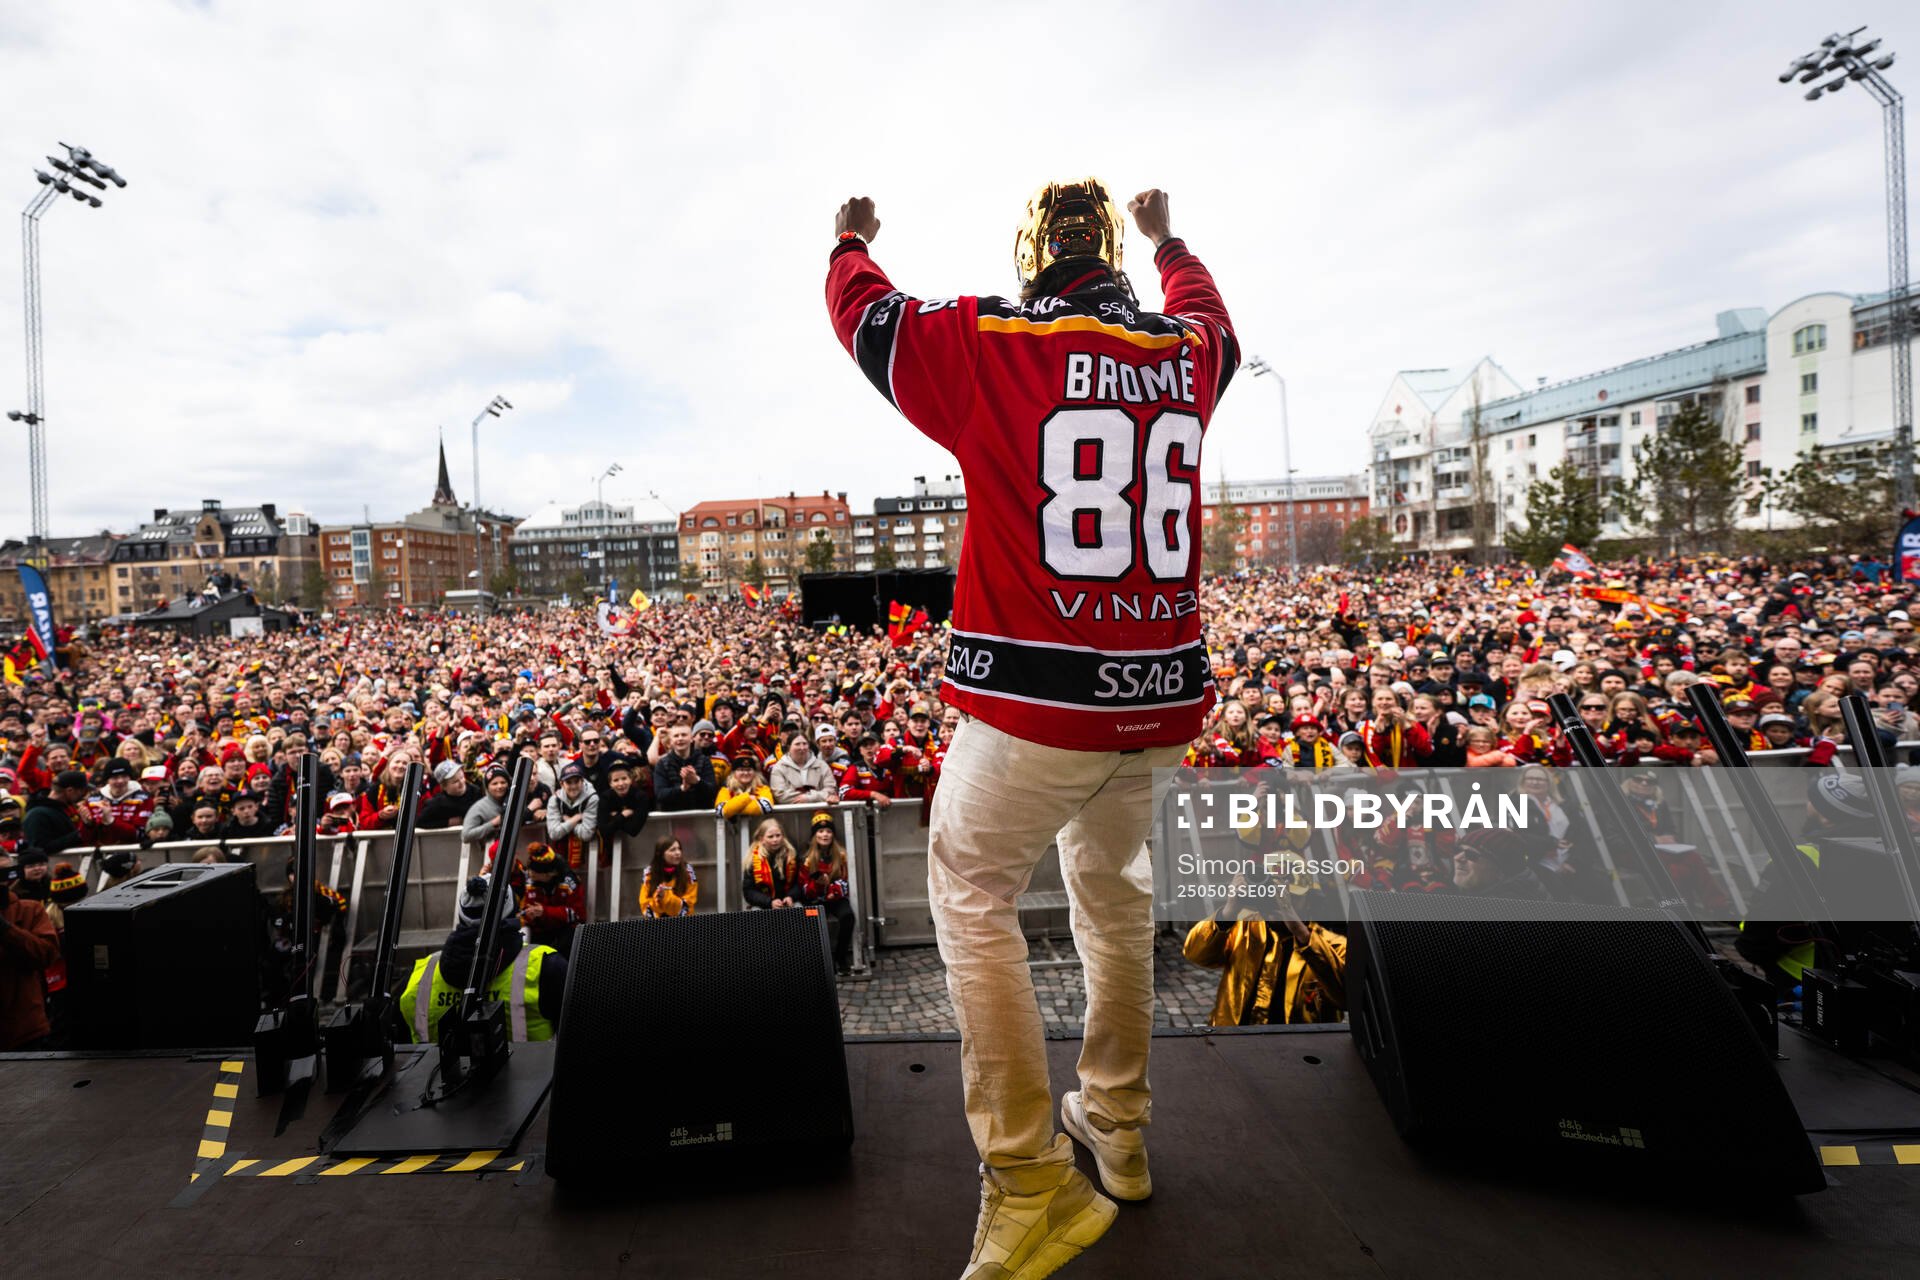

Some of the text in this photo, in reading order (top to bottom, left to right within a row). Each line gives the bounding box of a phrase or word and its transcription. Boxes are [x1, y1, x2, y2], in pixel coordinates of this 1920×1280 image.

[1099, 302, 1136, 324] SSAB
[1064, 345, 1196, 404] BROMÉ
[1039, 406, 1202, 582] 86
[1050, 589, 1198, 621] VINAB
[1094, 659, 1185, 699] SSAB
[670, 1126, 689, 1138] d&b
